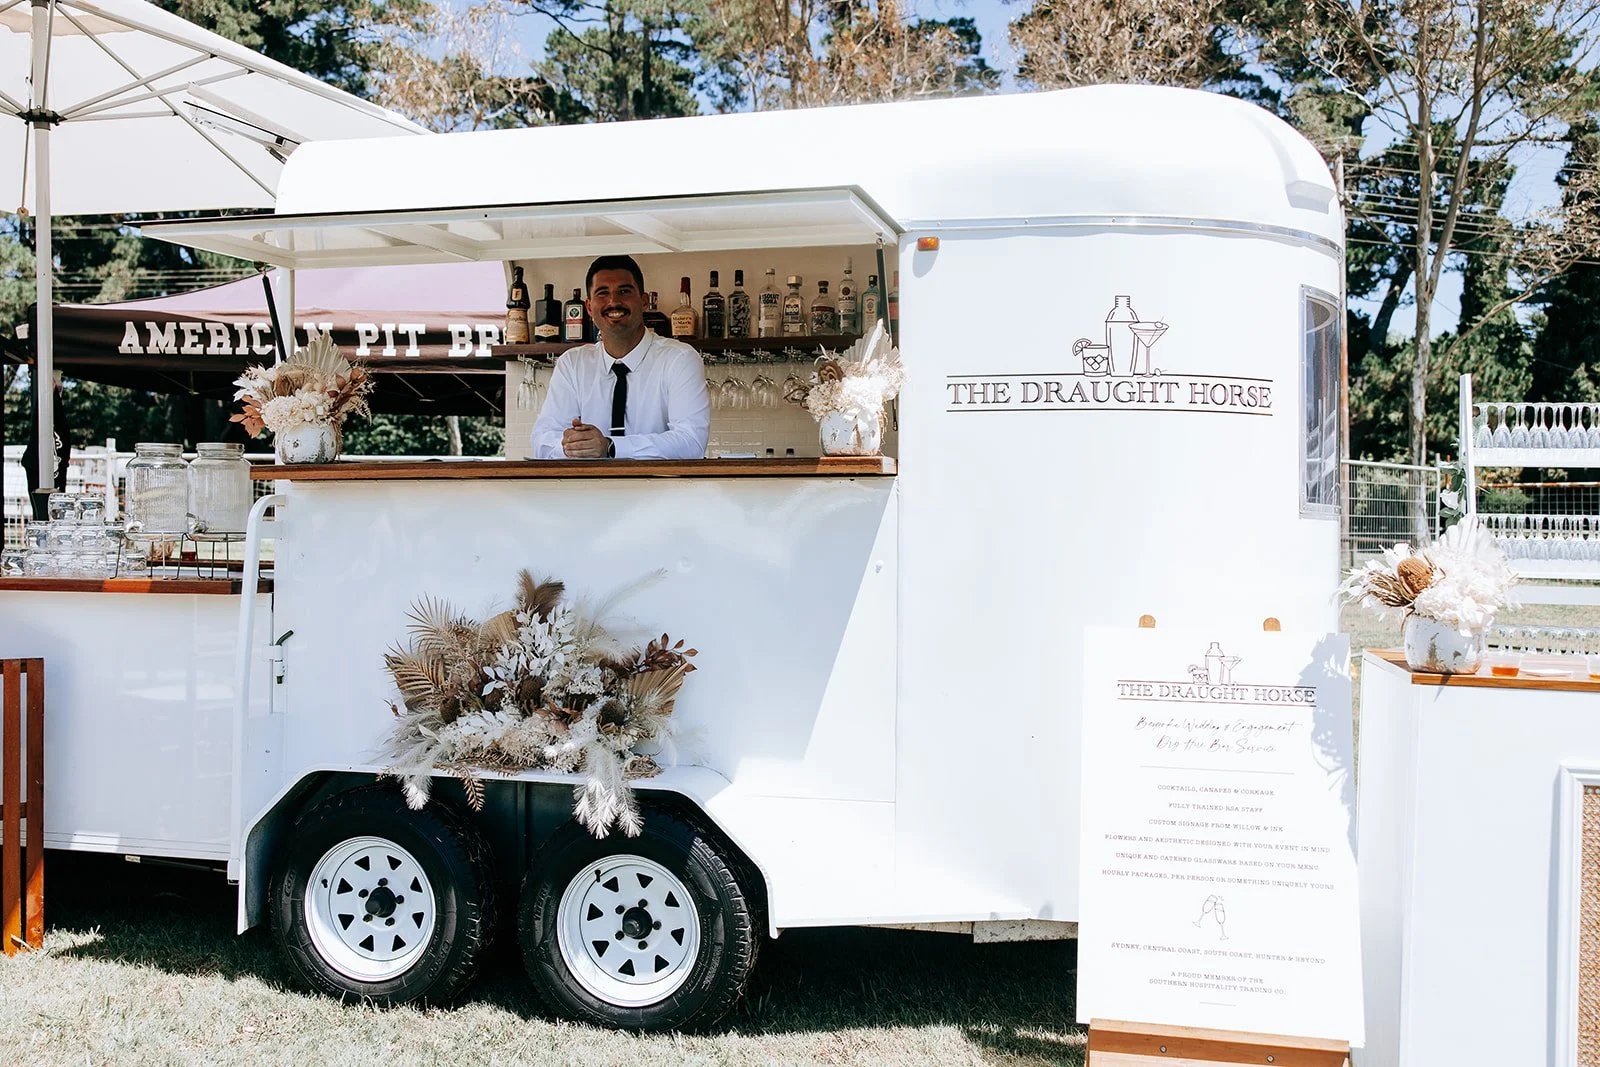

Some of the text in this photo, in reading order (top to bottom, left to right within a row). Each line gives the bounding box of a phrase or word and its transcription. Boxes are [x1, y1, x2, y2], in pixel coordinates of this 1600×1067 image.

[118, 321, 507, 357] AMERICN PIT BR
[946, 380, 1273, 409] THE DRAUGHT HORSE
[1116, 682, 1316, 704] THE DRAUGHT HORSE
[1183, 718, 1220, 735] Wedding
[1232, 718, 1303, 737] Engagement
[1156, 734, 1180, 751] Dry
[1208, 738, 1233, 753] Bar
[1235, 737, 1276, 754] Service
[1199, 786, 1232, 794] CANAPES
[1240, 788, 1276, 796] CORKAGE
[1191, 803, 1224, 811] TRAINED
[1177, 820, 1210, 828] SIGNAGE
[1232, 823, 1262, 831] WILLOW
[1155, 837, 1196, 845] AESTHETIC
[1195, 839, 1232, 847] DESIGNED
[1232, 841, 1252, 849] WITH
[1253, 842, 1274, 850] YOUR
[1115, 852, 1142, 860] UNIQUE
[1159, 855, 1194, 863] CATERED
[1193, 856, 1238, 866] GLASSWARE
[1238, 859, 1264, 867] BASED
[1275, 862, 1298, 870] YOUR
[1297, 863, 1320, 871] MENU
[1101, 869, 1130, 877] HOURLY
[1171, 873, 1186, 881] PER
[1186, 874, 1216, 882] PERSON
[1227, 877, 1272, 886] SOMETHING
[1271, 880, 1310, 889] UNIQUELY
[1310, 882, 1336, 891] YOURS
[1142, 944, 1176, 953] CENTRAL
[1203, 949, 1228, 957] SOUTH
[1255, 953, 1288, 961] HUNTER
[1295, 956, 1326, 965] BEYOND
[1148, 979, 1188, 987] SOUTHERN
[1189, 981, 1238, 990] HOSPITALITY
[1238, 985, 1274, 994] TRADING
[1203, 973, 1238, 981] MEMBER
